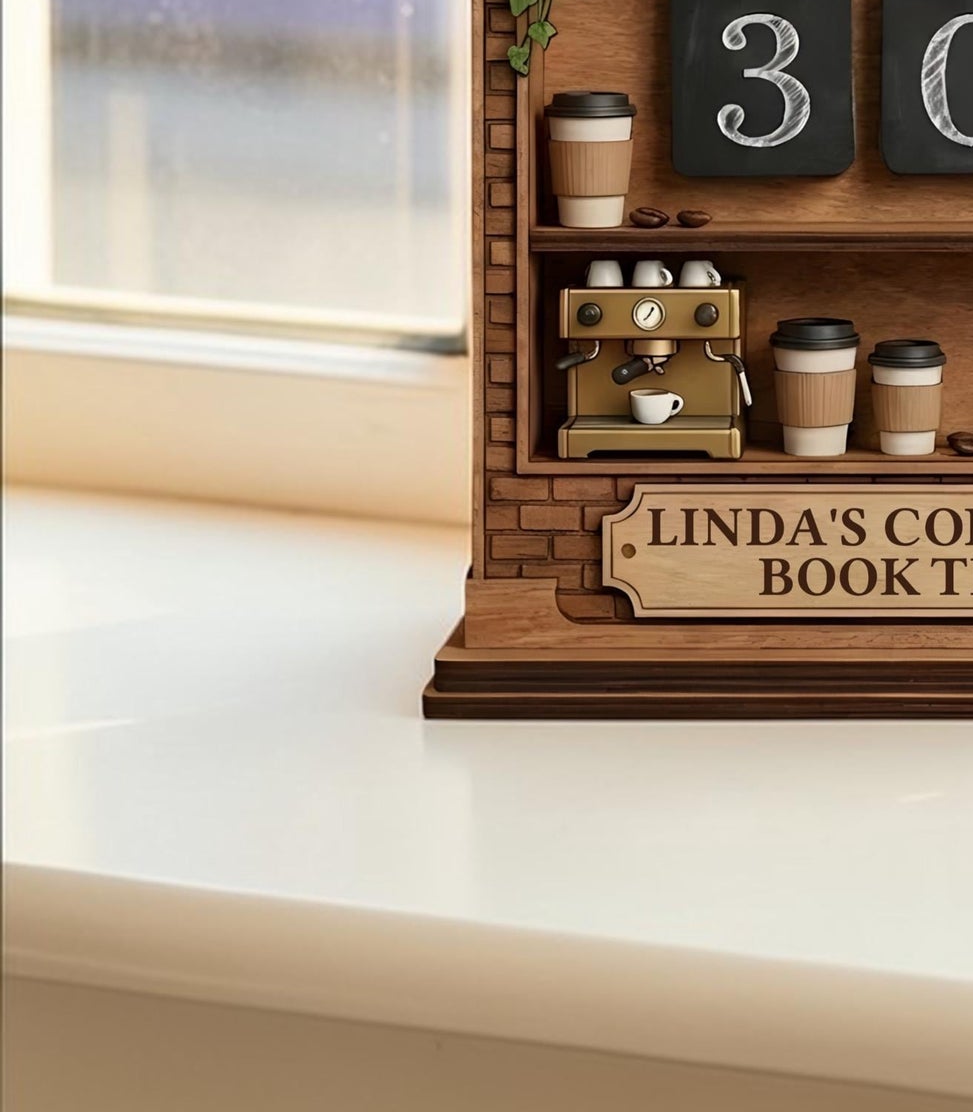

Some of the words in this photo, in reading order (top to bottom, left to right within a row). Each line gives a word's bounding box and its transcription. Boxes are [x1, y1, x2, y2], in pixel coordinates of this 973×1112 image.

[716, 13, 811, 148] 3
[646, 507, 867, 547] LINDA'S
[758, 557, 921, 597] BOOK
